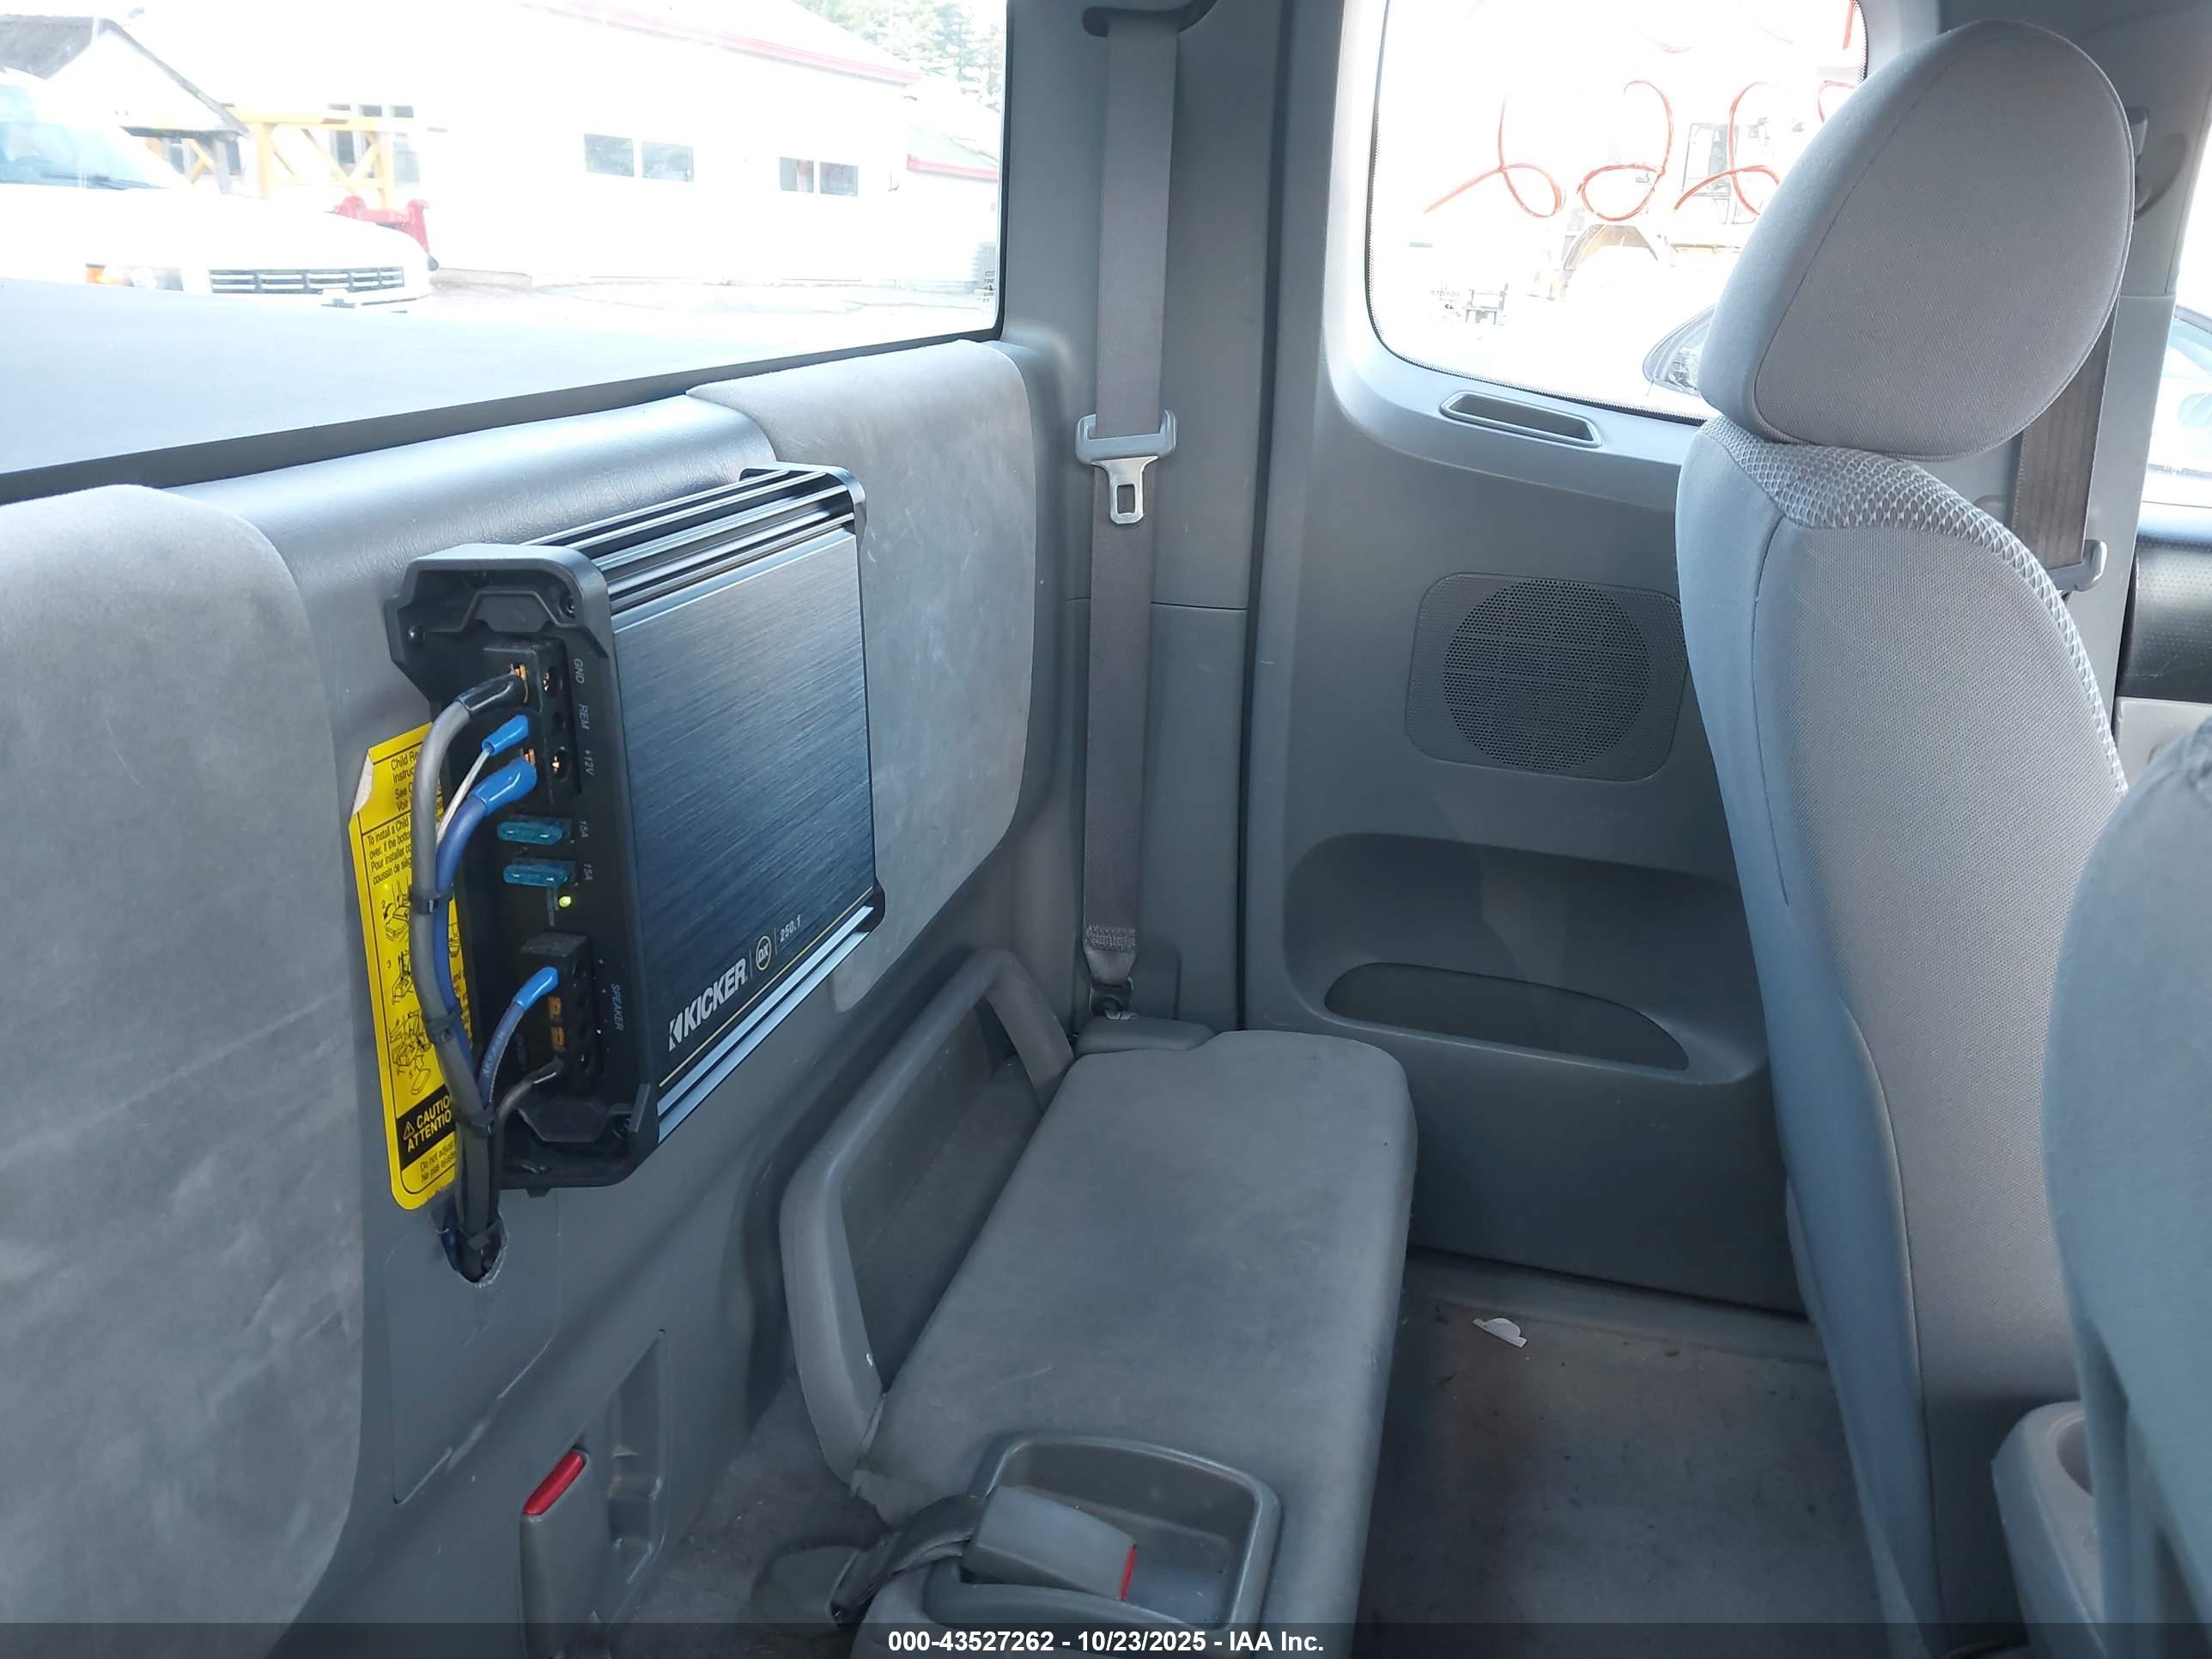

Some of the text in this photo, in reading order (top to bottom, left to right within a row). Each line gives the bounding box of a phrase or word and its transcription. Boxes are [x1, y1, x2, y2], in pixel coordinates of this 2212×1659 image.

[574, 658, 585, 684] GND
[578, 703, 591, 730] REM
[390, 754, 409, 770] Child
[585, 750, 596, 776] +12V
[367, 836, 375, 847] To
[374, 825, 391, 842] install
[395, 817, 410, 832] Child
[387, 838, 397, 850] the
[370, 860, 385, 872] Pour
[385, 848, 405, 865] installer
[372, 867, 393, 885] coussin
[392, 863, 401, 874] de
[386, 959, 392, 969] 3
[684, 957, 748, 1037] KICKER
[780, 915, 801, 944] 250.1
[611, 983, 624, 1031] SPEAKER
[408, 1070, 414, 1079] 5
[416, 1095, 450, 1128] CAUTIO
[407, 1109, 452, 1153] ATTENTIO
